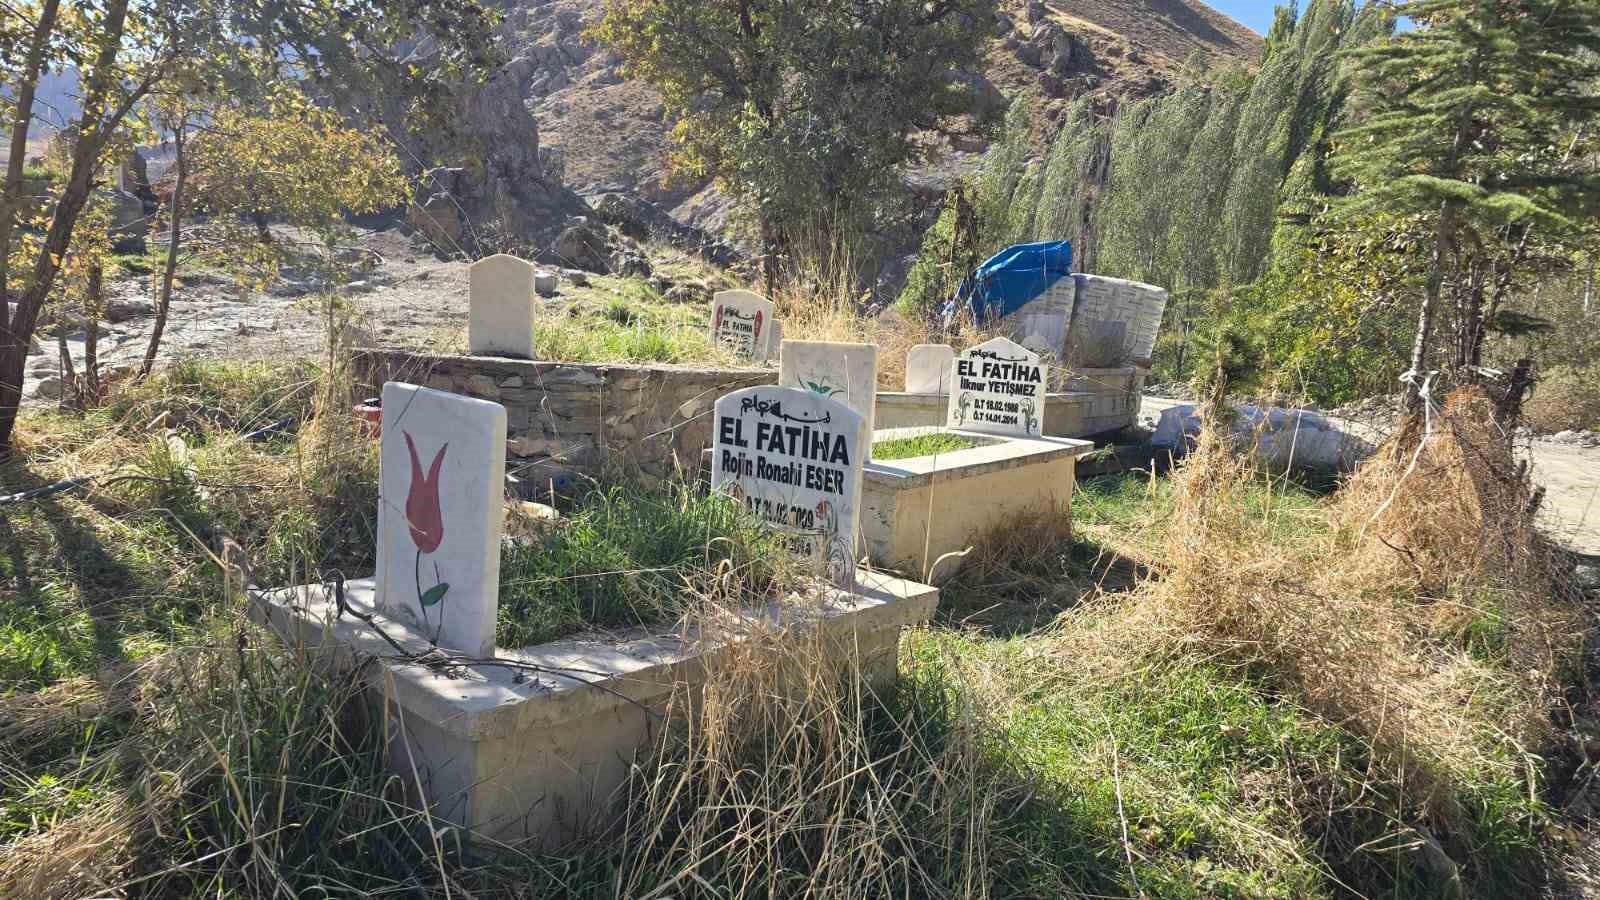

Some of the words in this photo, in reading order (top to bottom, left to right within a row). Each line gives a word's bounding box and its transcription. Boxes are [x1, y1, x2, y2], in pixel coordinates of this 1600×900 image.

[958, 360, 977, 377] EL
[982, 362, 1042, 383] FATİHA
[988, 380, 1036, 397] YETİŞMEZ
[756, 422, 849, 466] FATİHA
[805, 464, 844, 495] ESER
